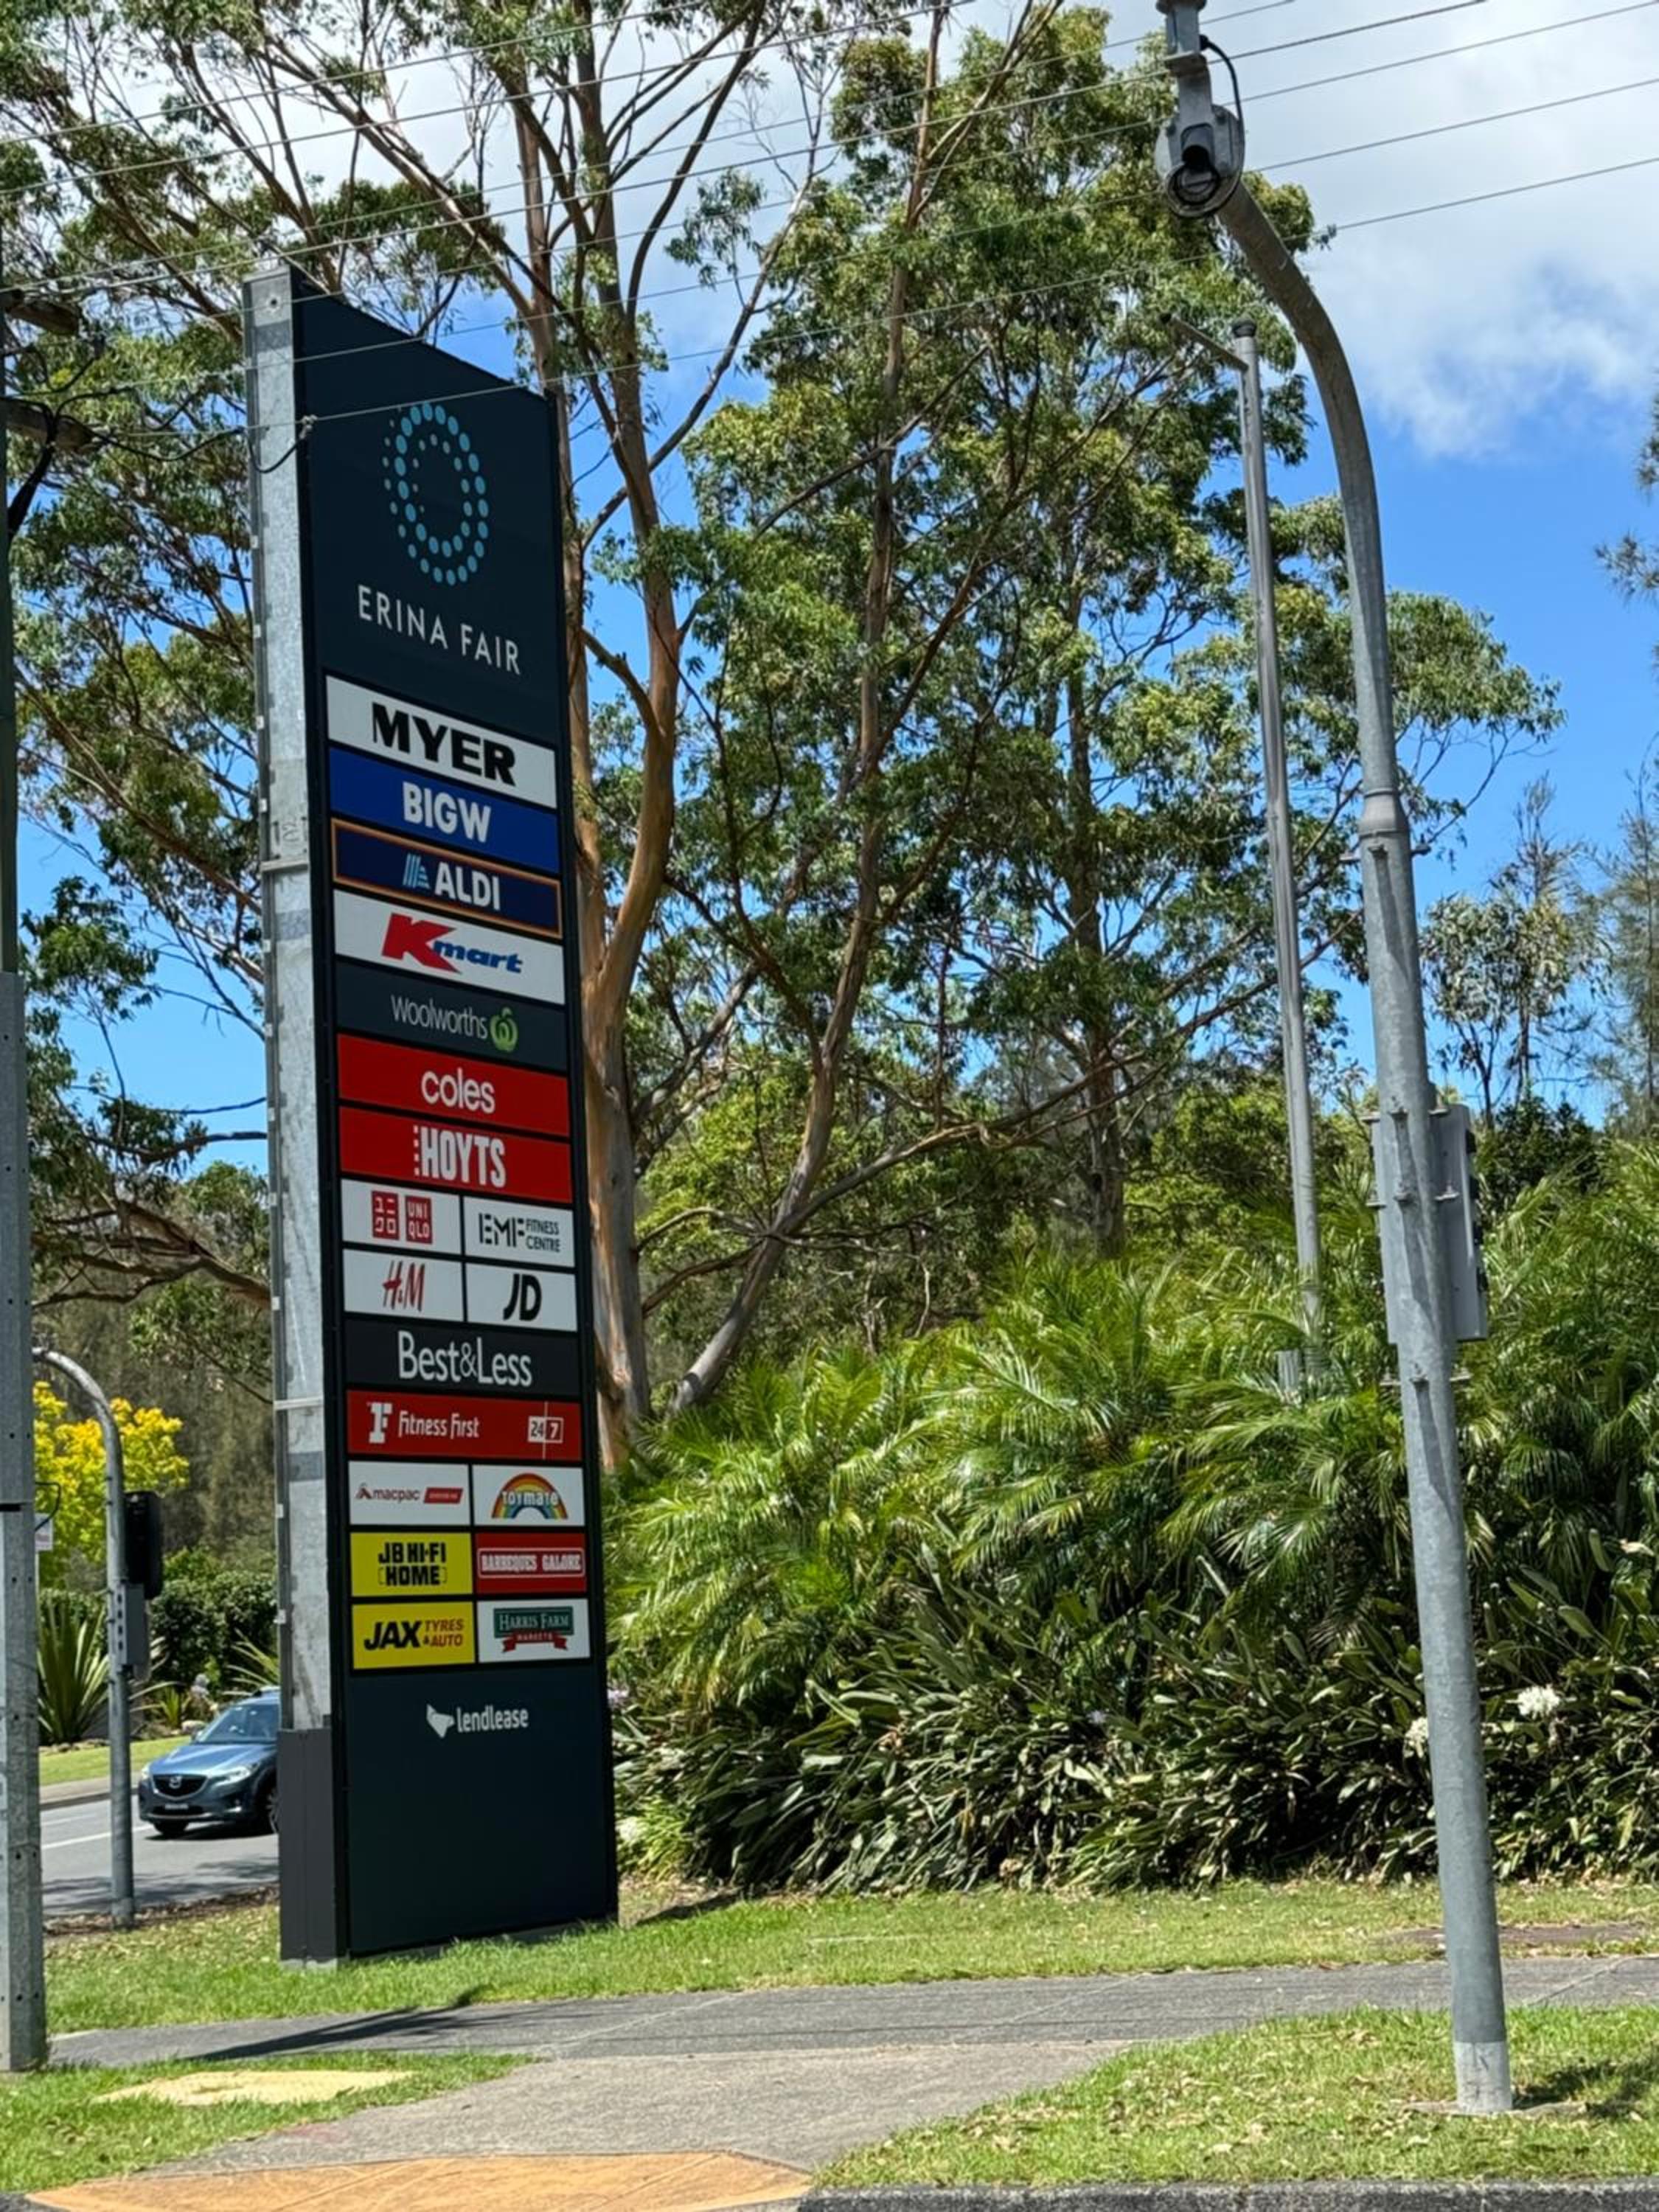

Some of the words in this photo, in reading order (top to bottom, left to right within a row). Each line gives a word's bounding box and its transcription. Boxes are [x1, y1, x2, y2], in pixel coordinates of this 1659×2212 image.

[358, 585, 448, 650] ERINA
[461, 623, 520, 675] FAIR
[372, 702, 515, 786] MYER
[435, 862, 500, 910] ALDI
[382, 913, 523, 974] Kmart
[391, 995, 488, 1040] Woolworths
[421, 1067, 495, 1113] coles
[420, 1125, 507, 1189] HOYTS
[526, 1218, 560, 1236] FITNESS
[526, 1235, 560, 1253] CENTRE
[383, 1260, 425, 1312] H&M
[503, 1273, 543, 1321] JD
[373, 1489, 420, 1503] macpac
[378, 1542, 403, 1563] JB
[542, 1554, 581, 1571] GALORE
[386, 1565, 440, 1586] HOME
[364, 1620, 422, 1651] JAX
[425, 1618, 464, 1632] TYRES
[456, 1705, 529, 1733] lendlease
